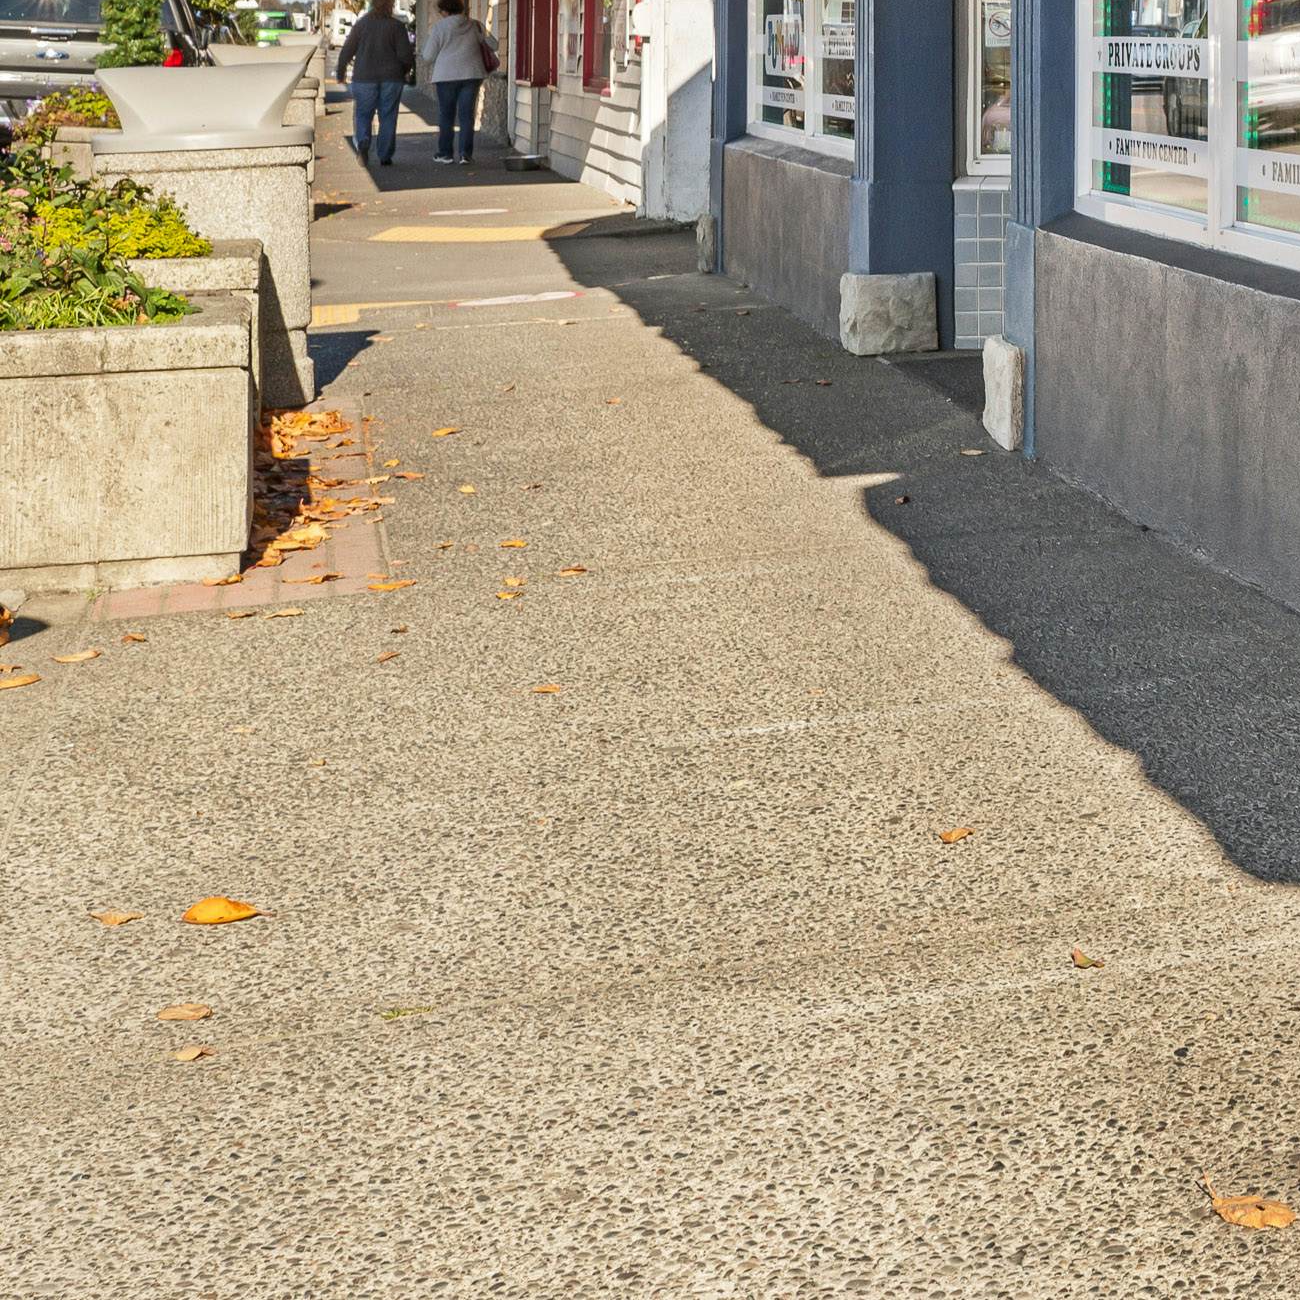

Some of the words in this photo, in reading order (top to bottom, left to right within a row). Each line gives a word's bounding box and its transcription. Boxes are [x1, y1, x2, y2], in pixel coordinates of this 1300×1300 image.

[1108, 42, 1153, 68] PRIVATE
[1154, 43, 1201, 72] GROUPS
[1115, 137, 1142, 158] FAMILY
[1142, 141, 1158, 161] FUN
[1158, 144, 1189, 166] CENTER
